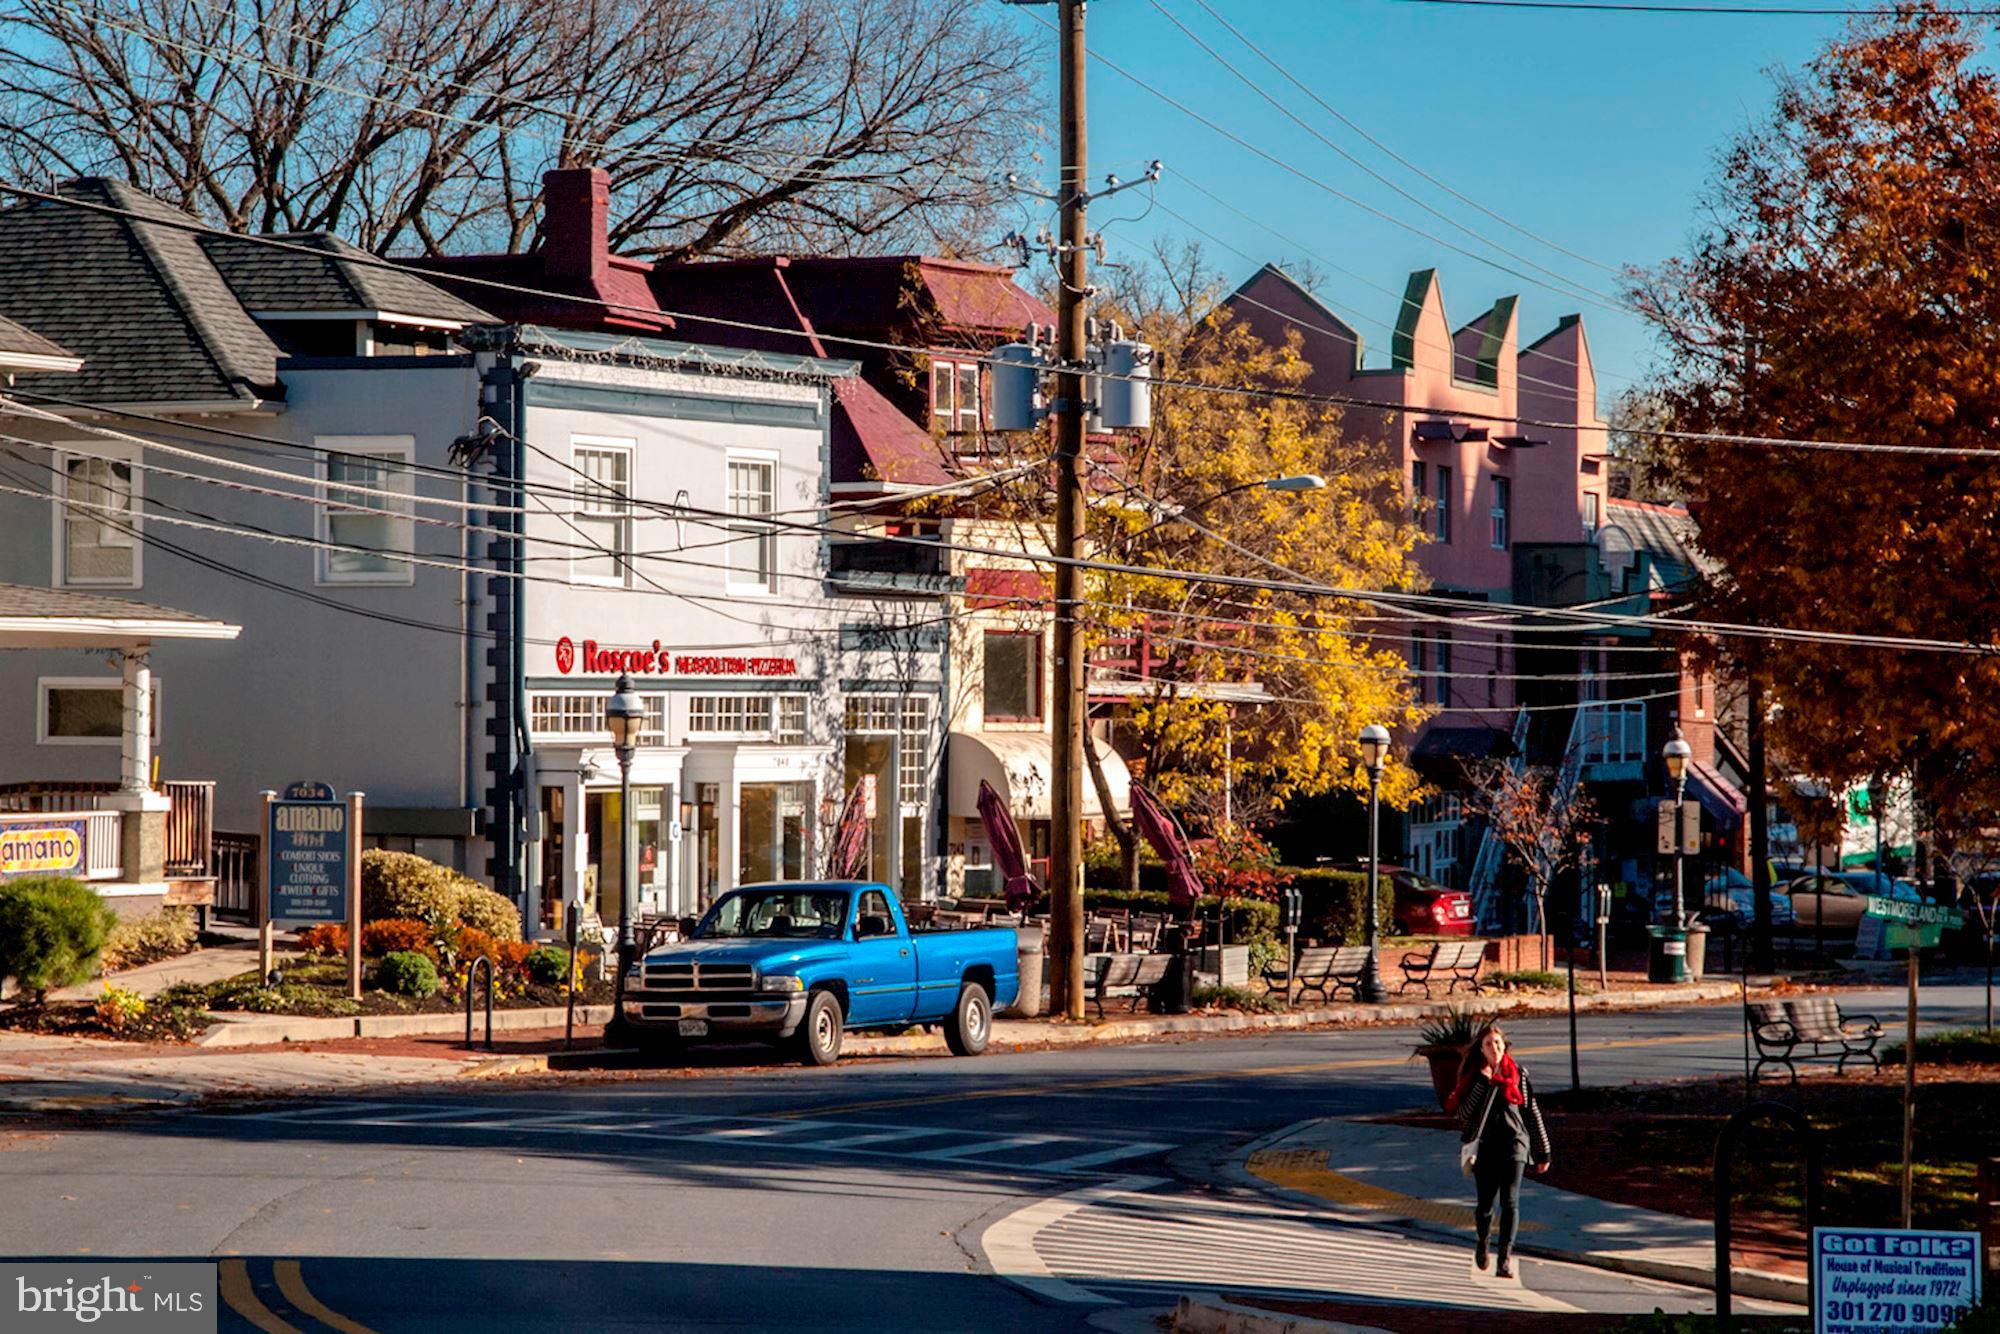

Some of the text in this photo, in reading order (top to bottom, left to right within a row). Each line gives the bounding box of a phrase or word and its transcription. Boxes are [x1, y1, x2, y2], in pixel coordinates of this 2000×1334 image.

[583, 639, 669, 673] Roscoe's
[292, 786, 325, 799] 7034
[275, 805, 344, 832] amano
[2, 839, 75, 861] amano
[289, 873, 329, 884] CLOTHING
[294, 863, 325, 873] UNIQUE
[1868, 896, 1936, 922] WESTMORELAND
[1822, 1235, 1971, 1256] Got Folk?
[1826, 1257, 1966, 1277] House of Musical Traditions
[1832, 1276, 1962, 1299] Unplugged since 1972!
[1827, 1300, 1864, 1320] 301
[1869, 1302, 1906, 1322] 270
